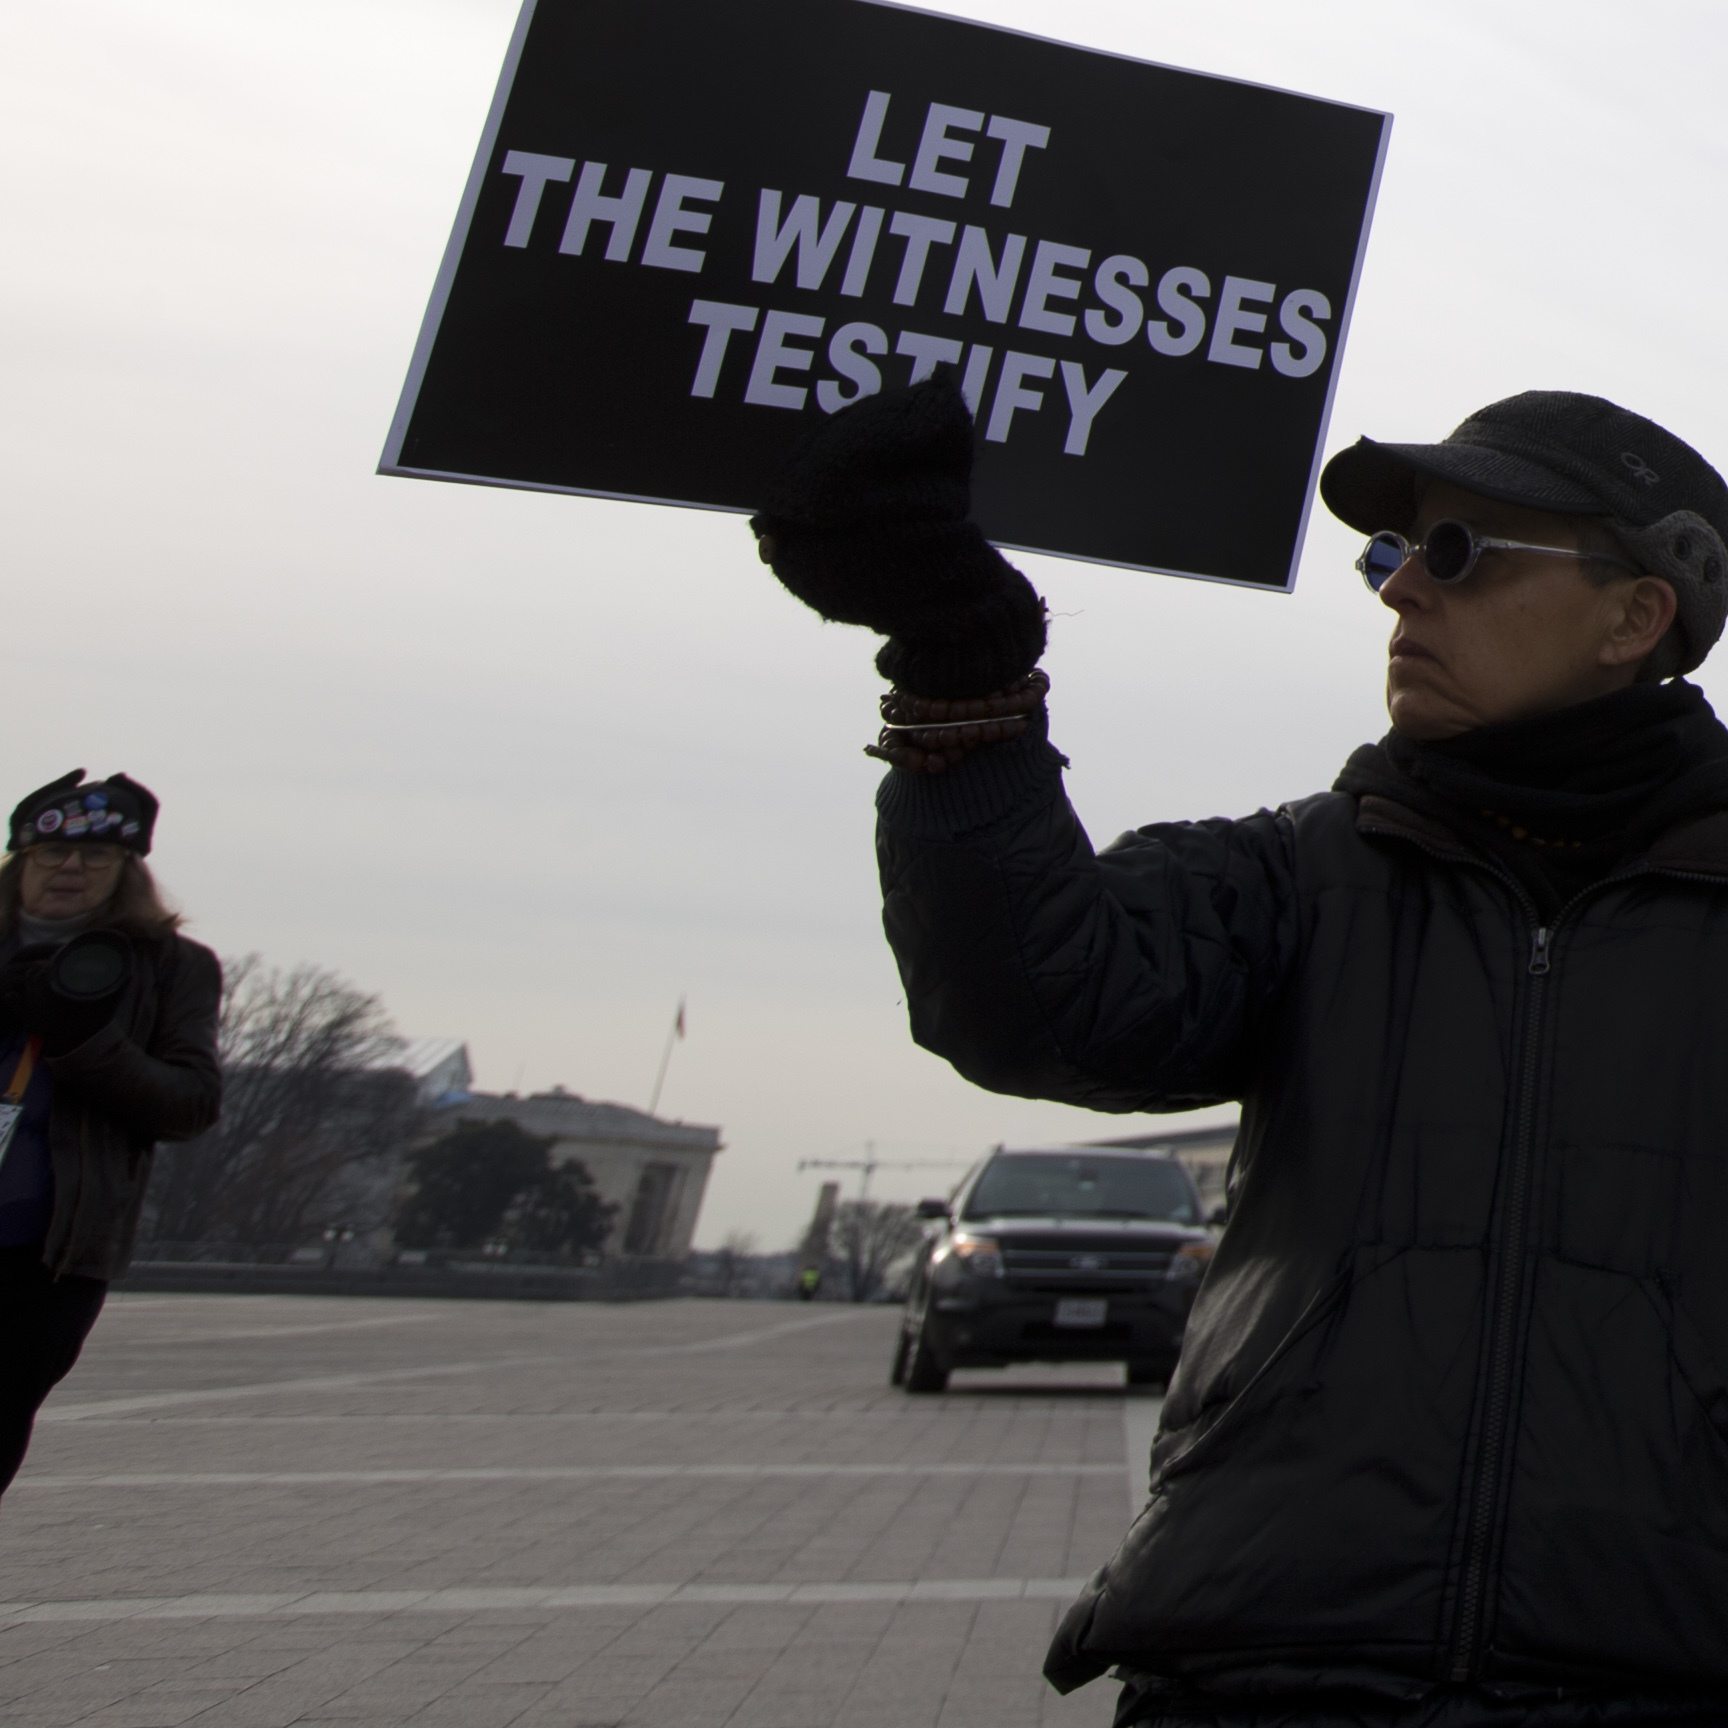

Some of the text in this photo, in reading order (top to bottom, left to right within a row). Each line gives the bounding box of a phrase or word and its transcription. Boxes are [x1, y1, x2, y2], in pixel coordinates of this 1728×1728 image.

[848, 91, 1050, 208] LET
[503, 151, 1331, 378] THE WITNESSES
